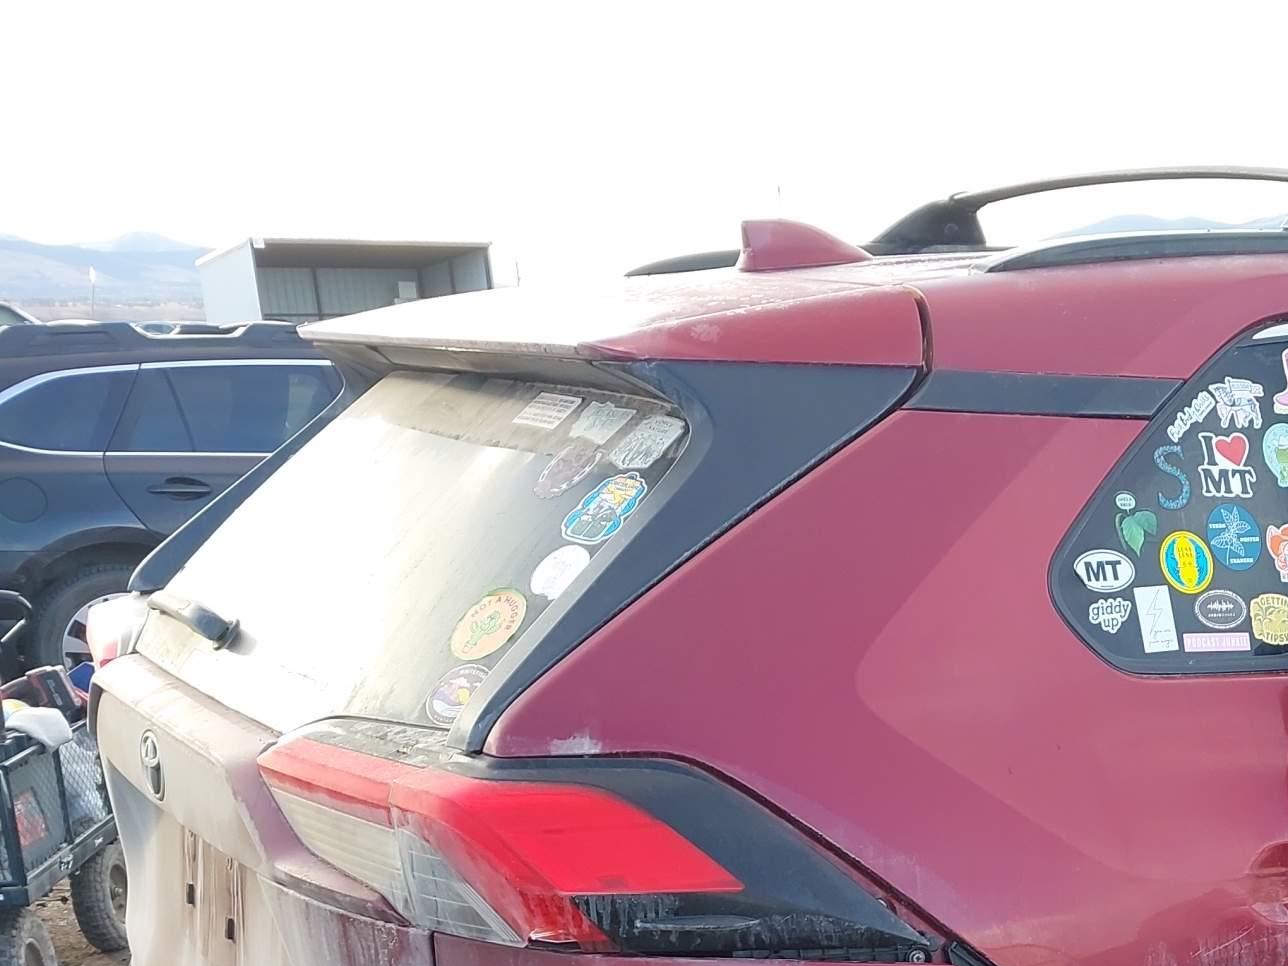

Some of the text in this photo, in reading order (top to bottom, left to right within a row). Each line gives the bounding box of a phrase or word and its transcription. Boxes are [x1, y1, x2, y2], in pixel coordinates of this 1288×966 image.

[1200, 467, 1254, 495] MT
[1083, 559, 1122, 583] MT
[1091, 601, 1130, 621] giddy
[1103, 617, 1119, 631] up
[1264, 632, 1288, 642] TIPSY
